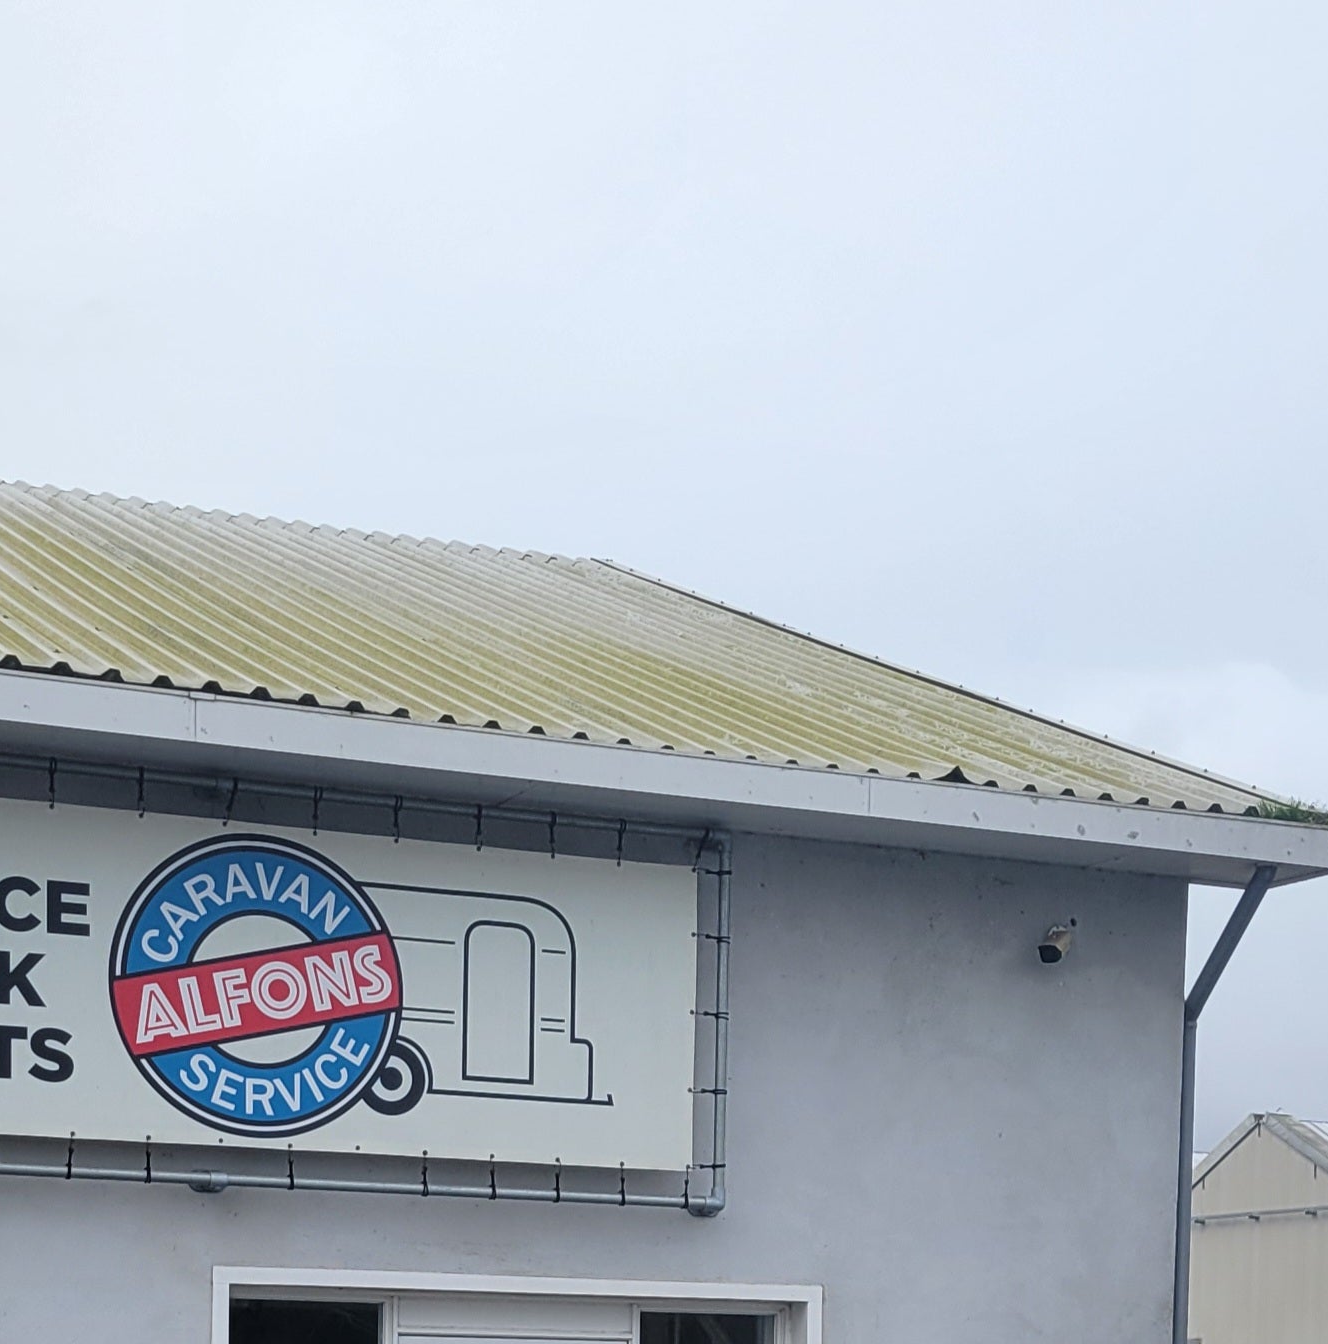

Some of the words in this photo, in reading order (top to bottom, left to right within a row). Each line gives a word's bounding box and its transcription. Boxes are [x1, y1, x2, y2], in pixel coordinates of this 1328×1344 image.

[140, 862, 351, 963] CARAVAN
[135, 944, 393, 1045] ALFONS
[179, 1027, 370, 1117] SERVICE
